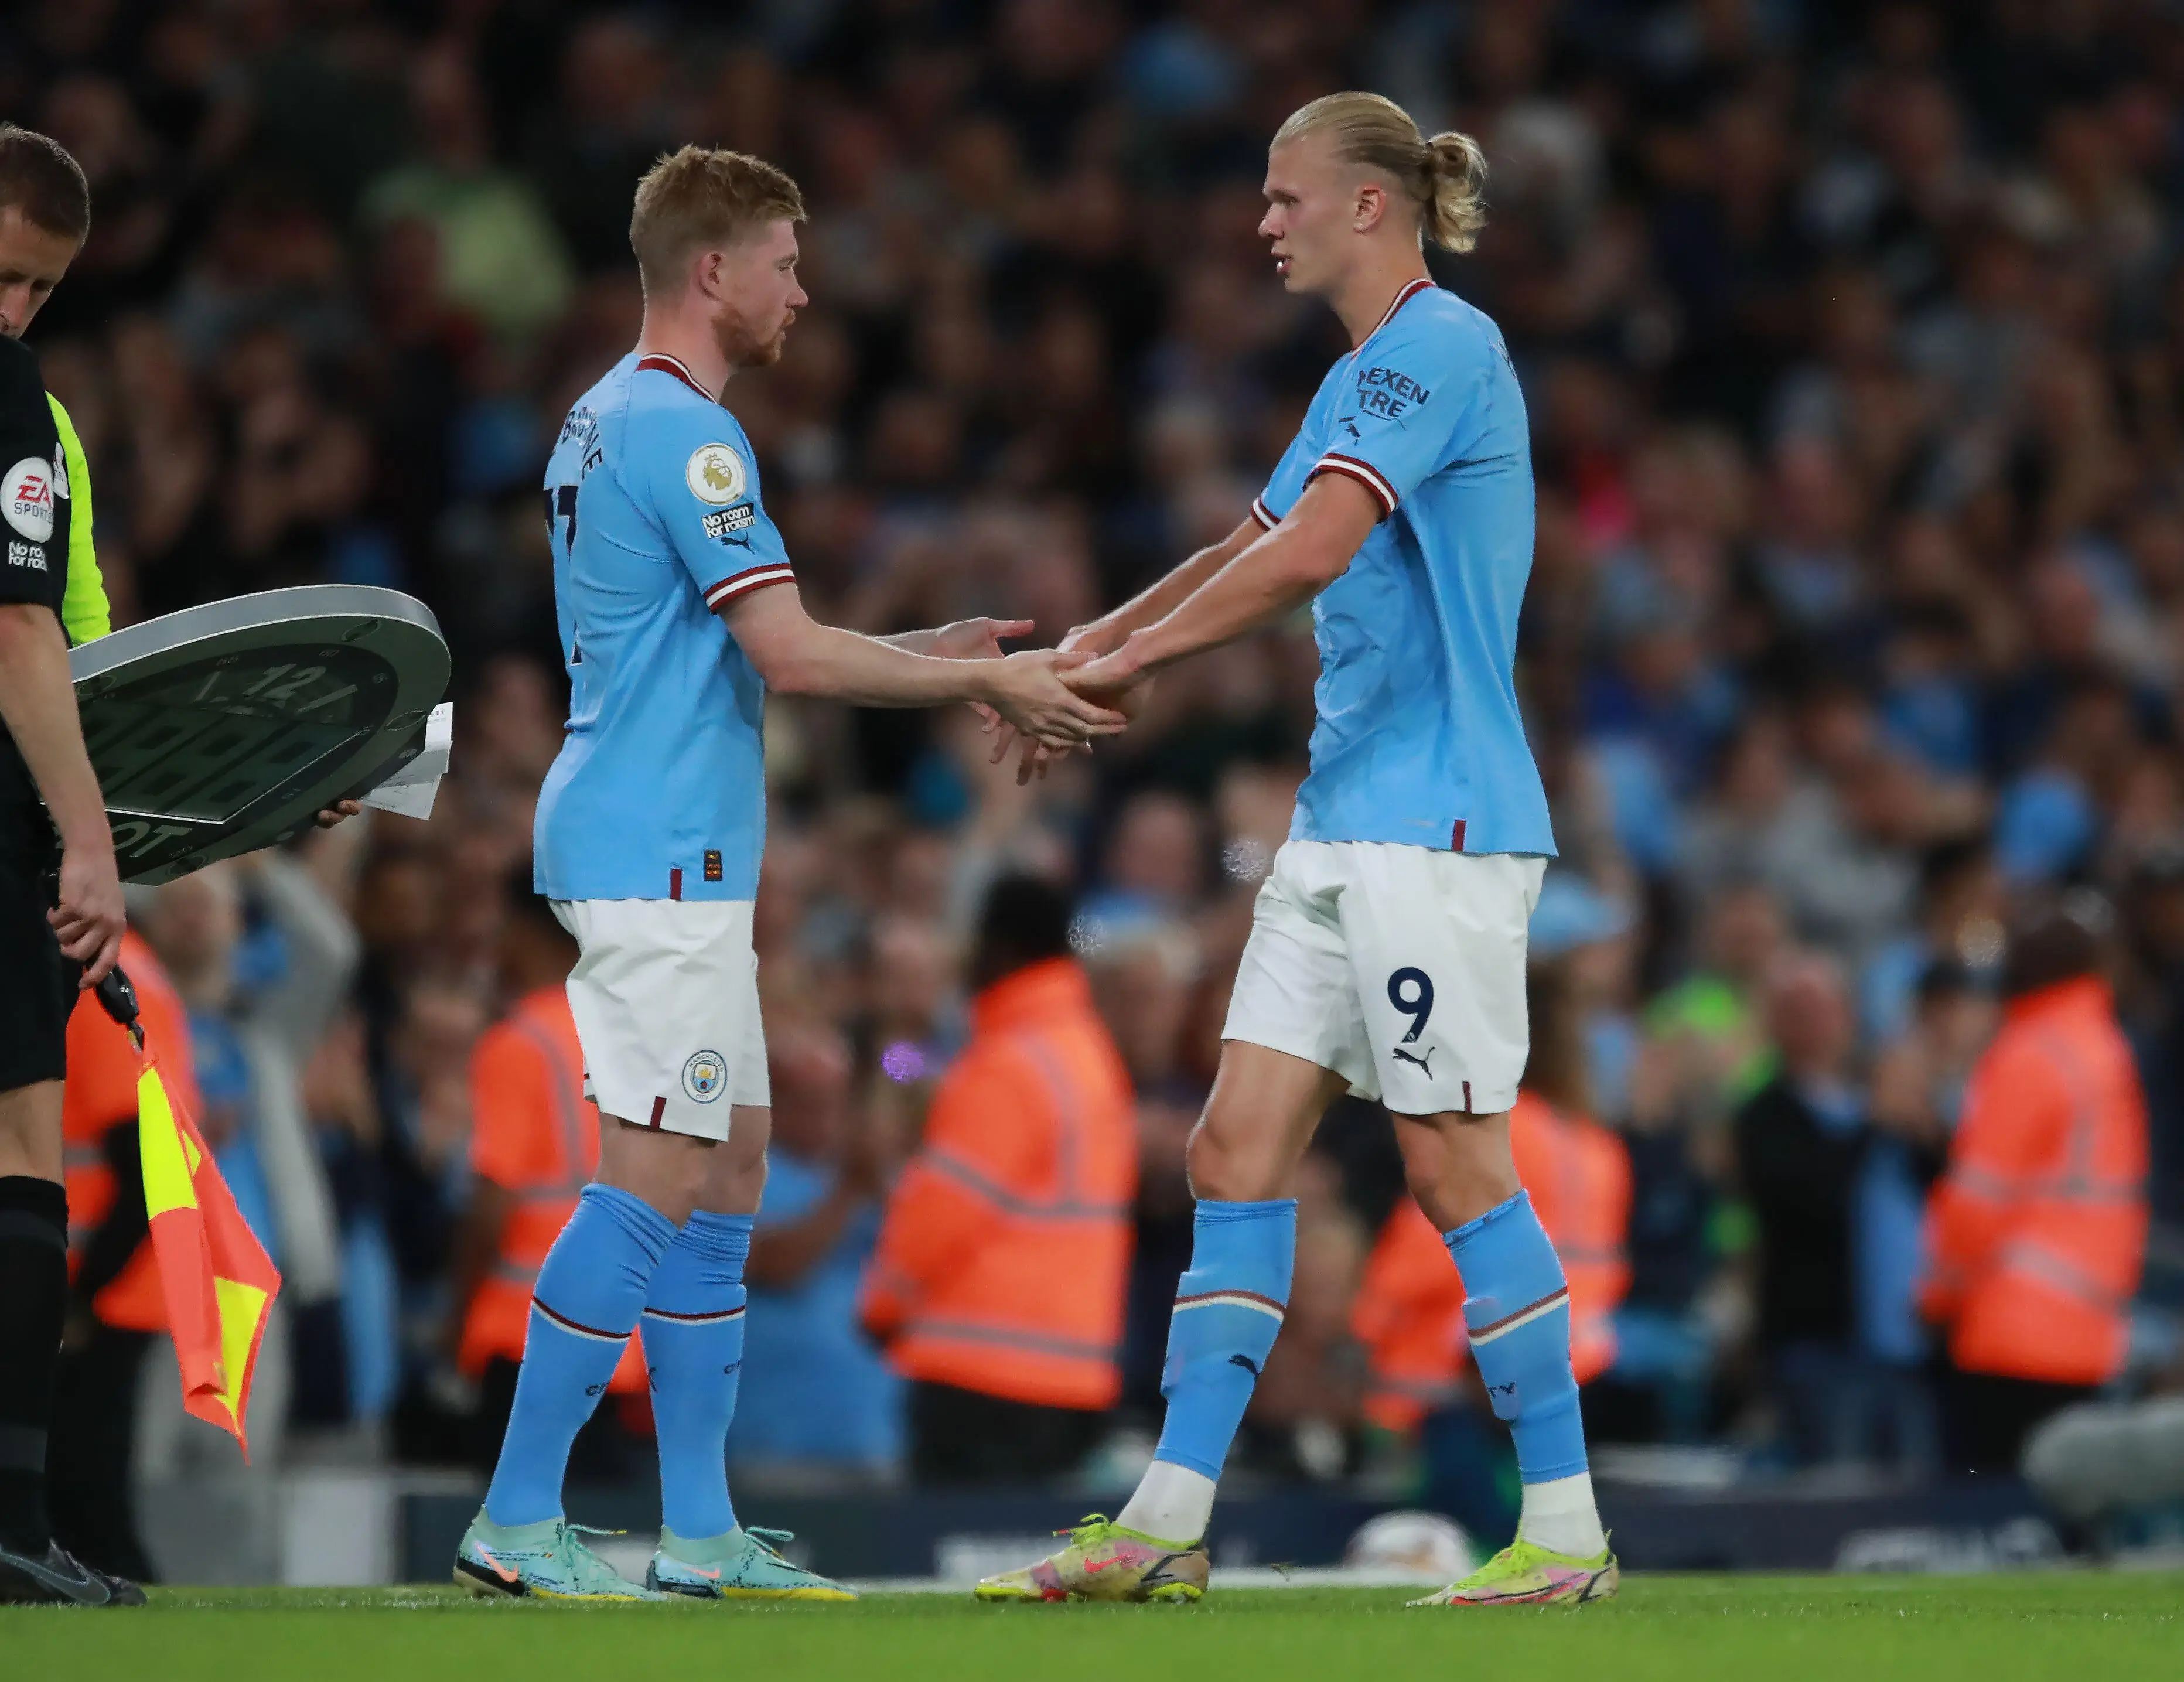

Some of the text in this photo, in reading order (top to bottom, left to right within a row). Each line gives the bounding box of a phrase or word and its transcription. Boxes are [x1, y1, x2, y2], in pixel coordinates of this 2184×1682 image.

[16, 475, 52, 509] EA
[702, 506, 750, 527] No room
[9, 541, 28, 555] No
[1387, 967, 1434, 1043] 9
